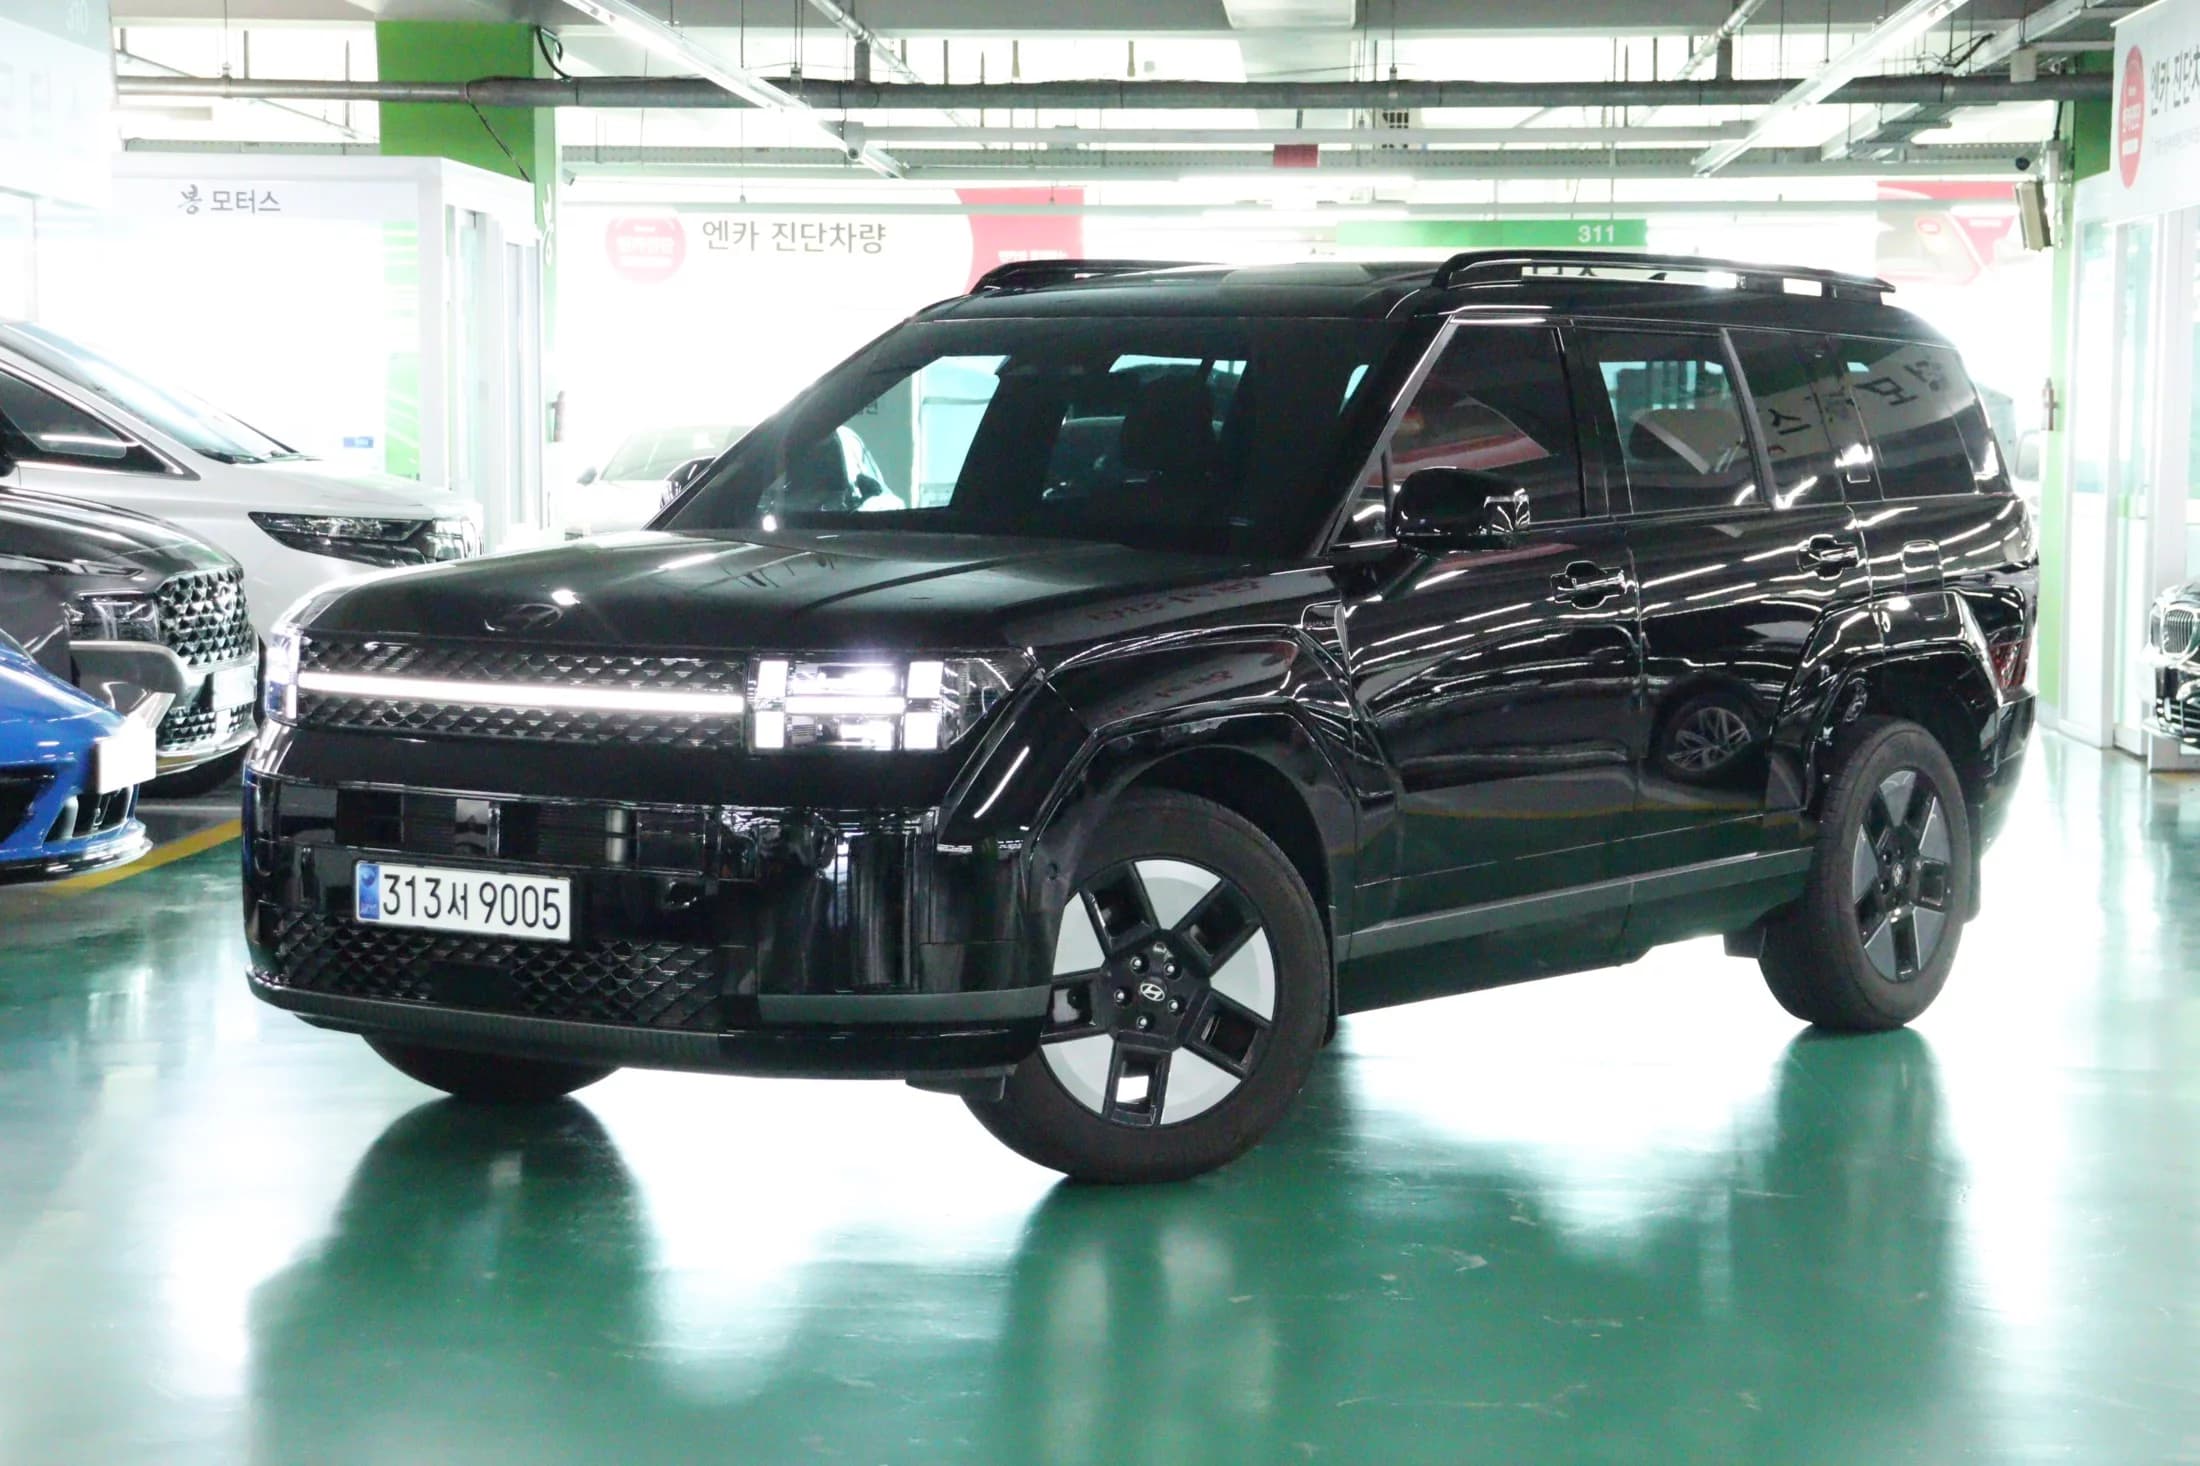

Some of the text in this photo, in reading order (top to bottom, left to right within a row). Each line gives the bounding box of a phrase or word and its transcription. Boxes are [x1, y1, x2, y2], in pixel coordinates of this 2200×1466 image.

[210, 189, 281, 214] 모터스
[702, 219, 759, 253] 엔카
[770, 219, 887, 255] 진단차량
[1577, 225, 1616, 243] 311
[383, 873, 561, 930] 313서 9005
